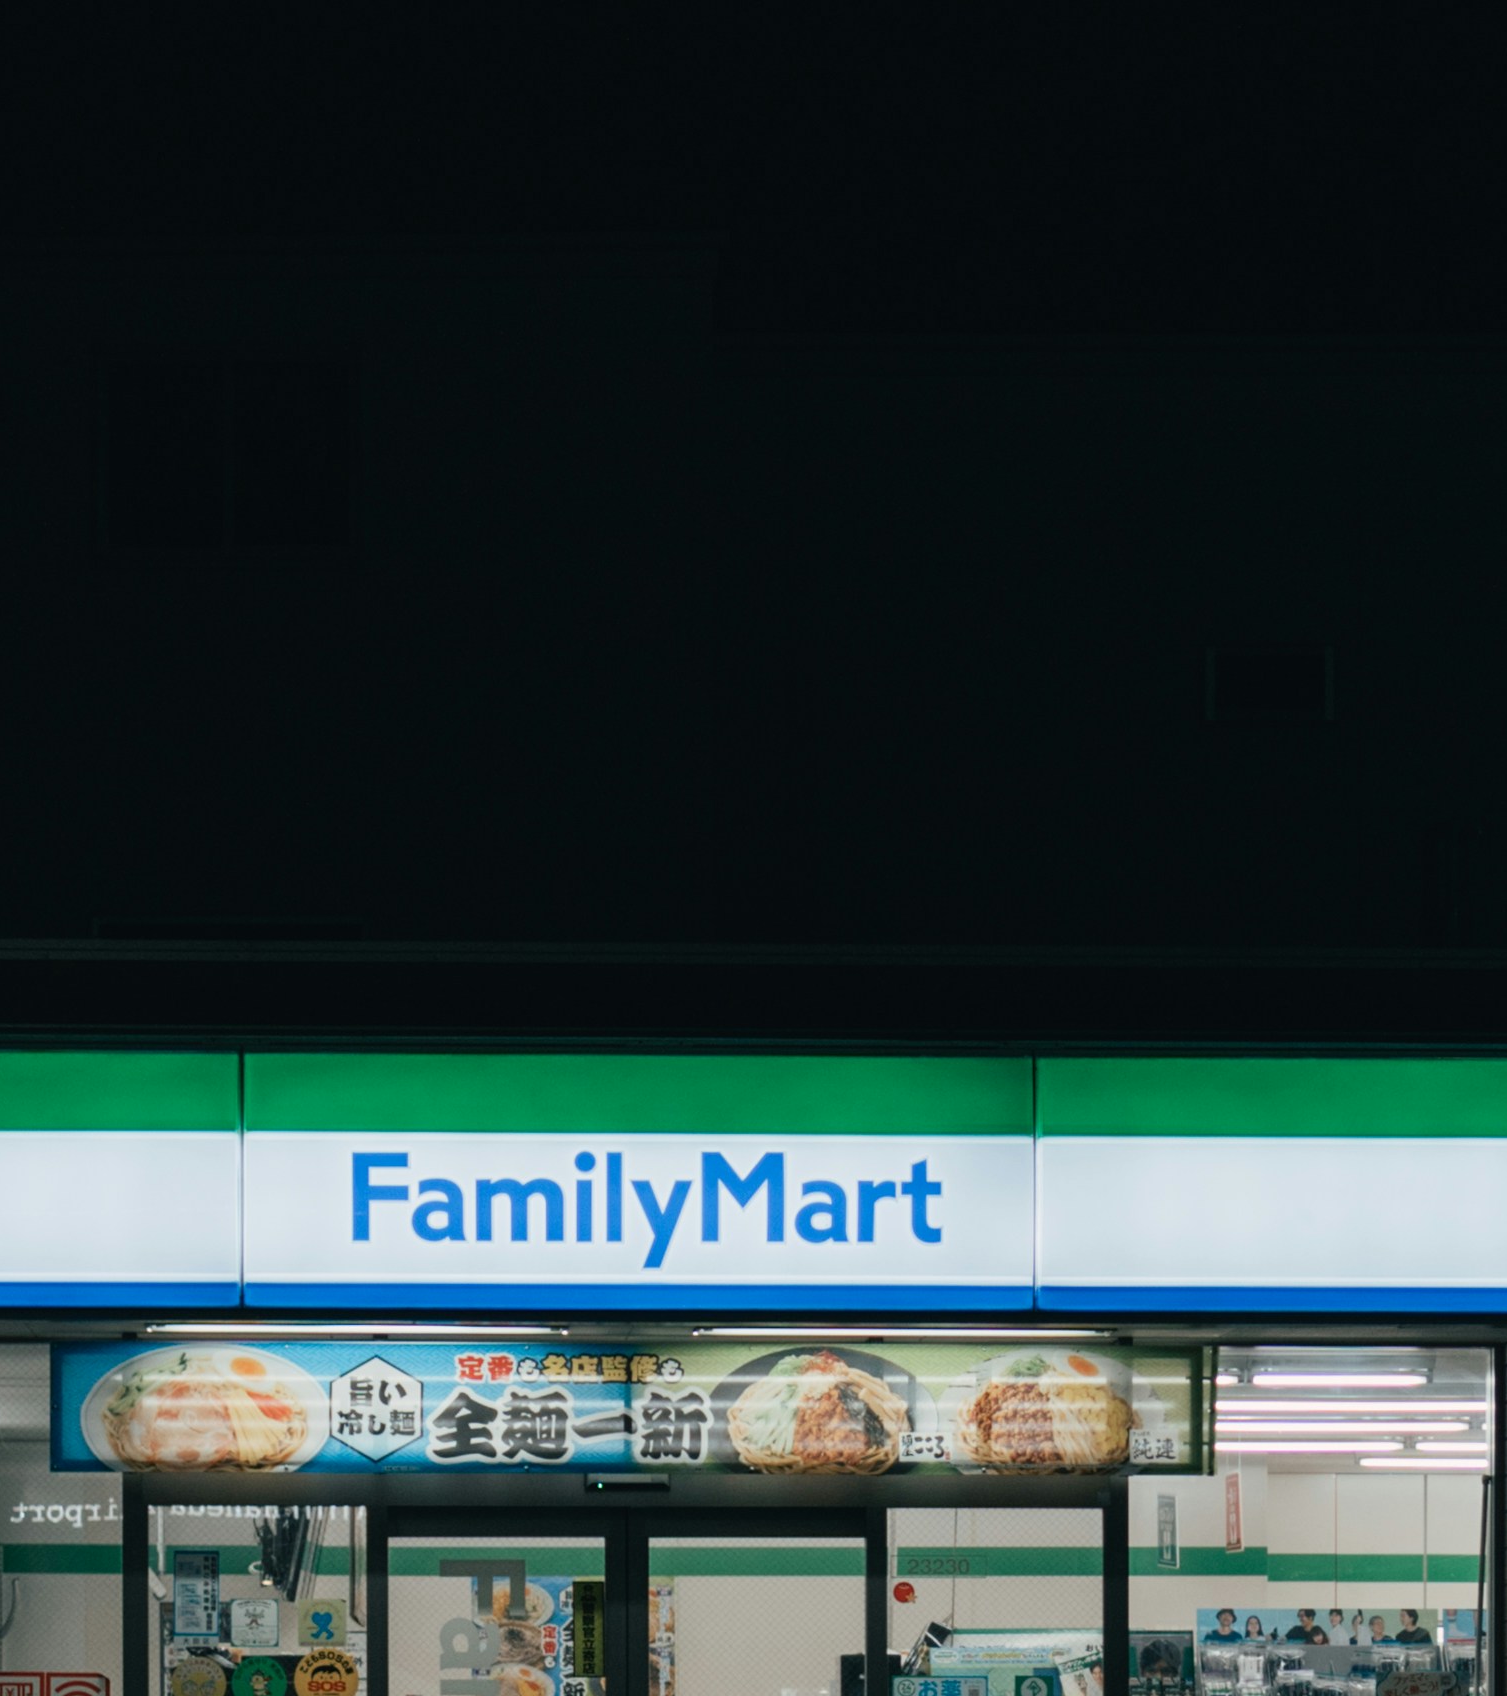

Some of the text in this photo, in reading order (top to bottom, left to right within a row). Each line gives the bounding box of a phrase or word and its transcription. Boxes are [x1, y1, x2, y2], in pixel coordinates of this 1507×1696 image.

[351, 1151, 944, 1269] FamilyMart
[456, 1354, 685, 1384] 定番も名店監修も
[348, 1380, 407, 1408] 旨い
[337, 1409, 417, 1437] 冷し麺
[431, 1390, 709, 1461] 全麺一新
[907, 1559, 970, 1575] 23230
[308, 1681, 346, 1692] SOS
